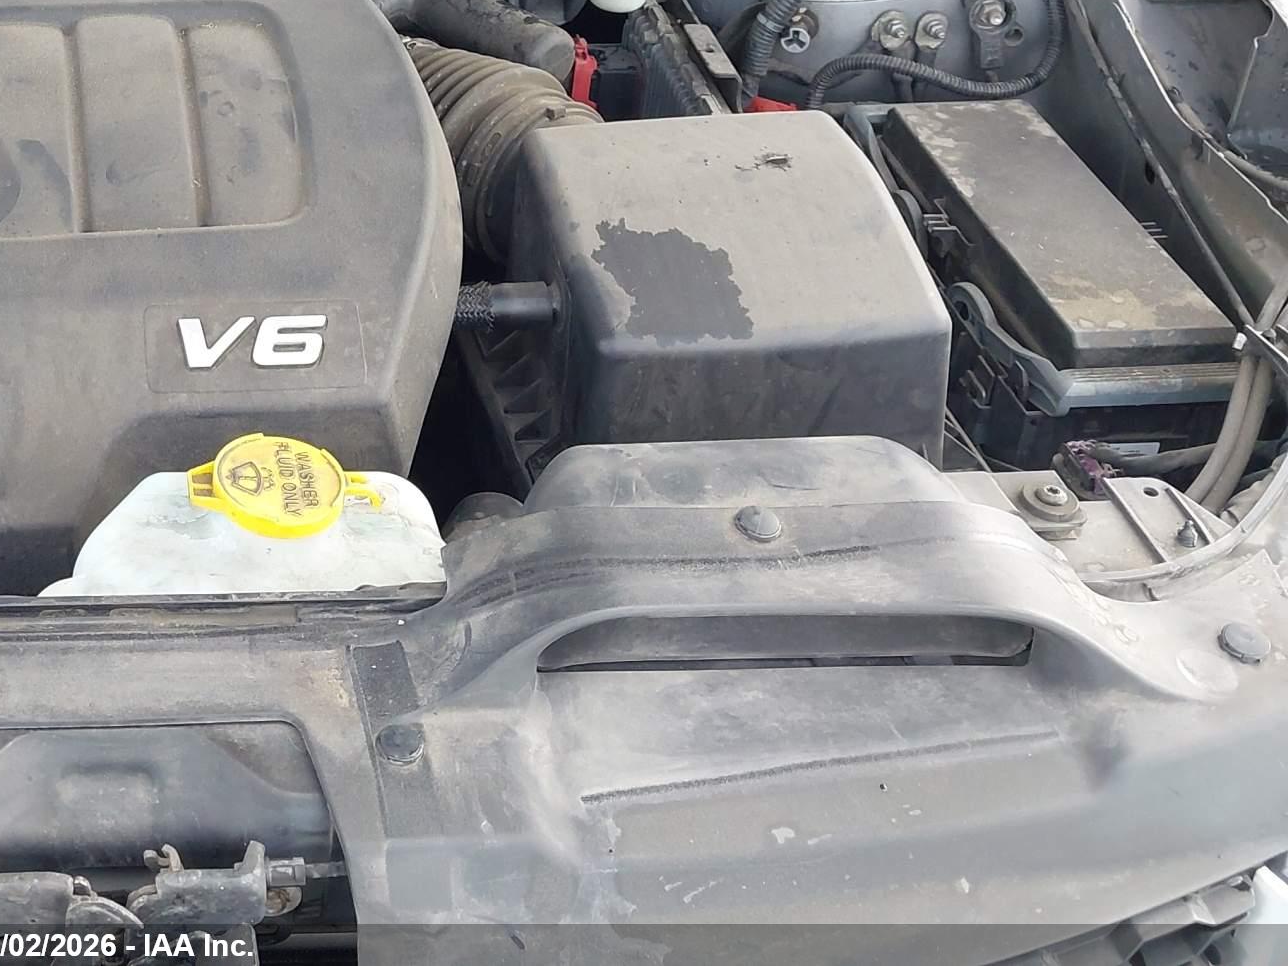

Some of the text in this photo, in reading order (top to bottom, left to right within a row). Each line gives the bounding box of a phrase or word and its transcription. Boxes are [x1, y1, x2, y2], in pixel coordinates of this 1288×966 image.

[176, 314, 328, 370] V6
[274, 441, 302, 517] FLUID ONLY
[295, 451, 319, 509] WASHER
